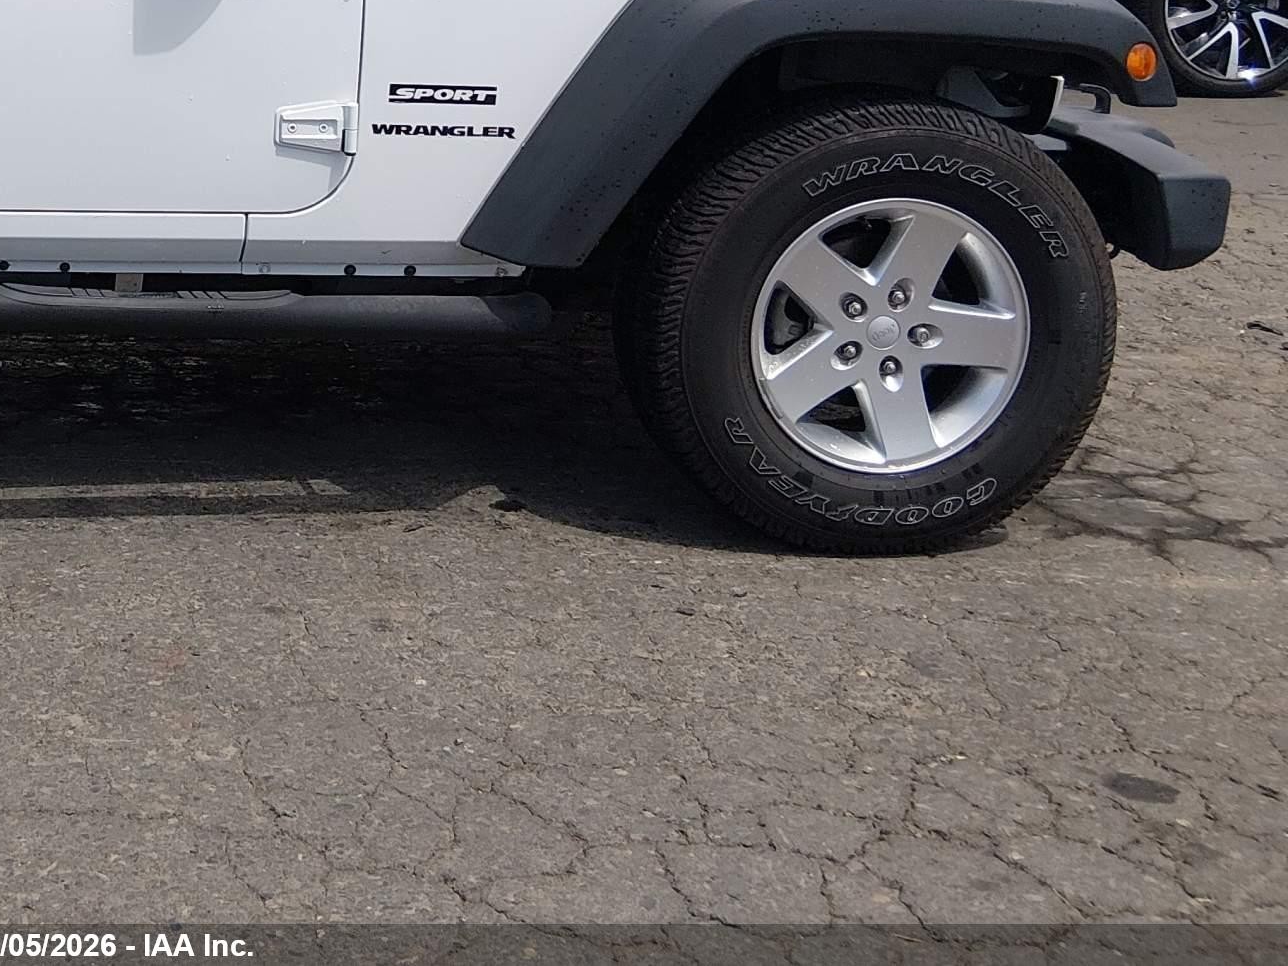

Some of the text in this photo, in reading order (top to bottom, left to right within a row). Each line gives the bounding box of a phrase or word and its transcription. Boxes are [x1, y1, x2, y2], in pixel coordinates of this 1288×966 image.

[391, 87, 496, 103] SPORT
[371, 123, 516, 139] WRANGLER
[802, 153, 1069, 259] WRANGLER
[724, 416, 998, 526] GOODYEAR
